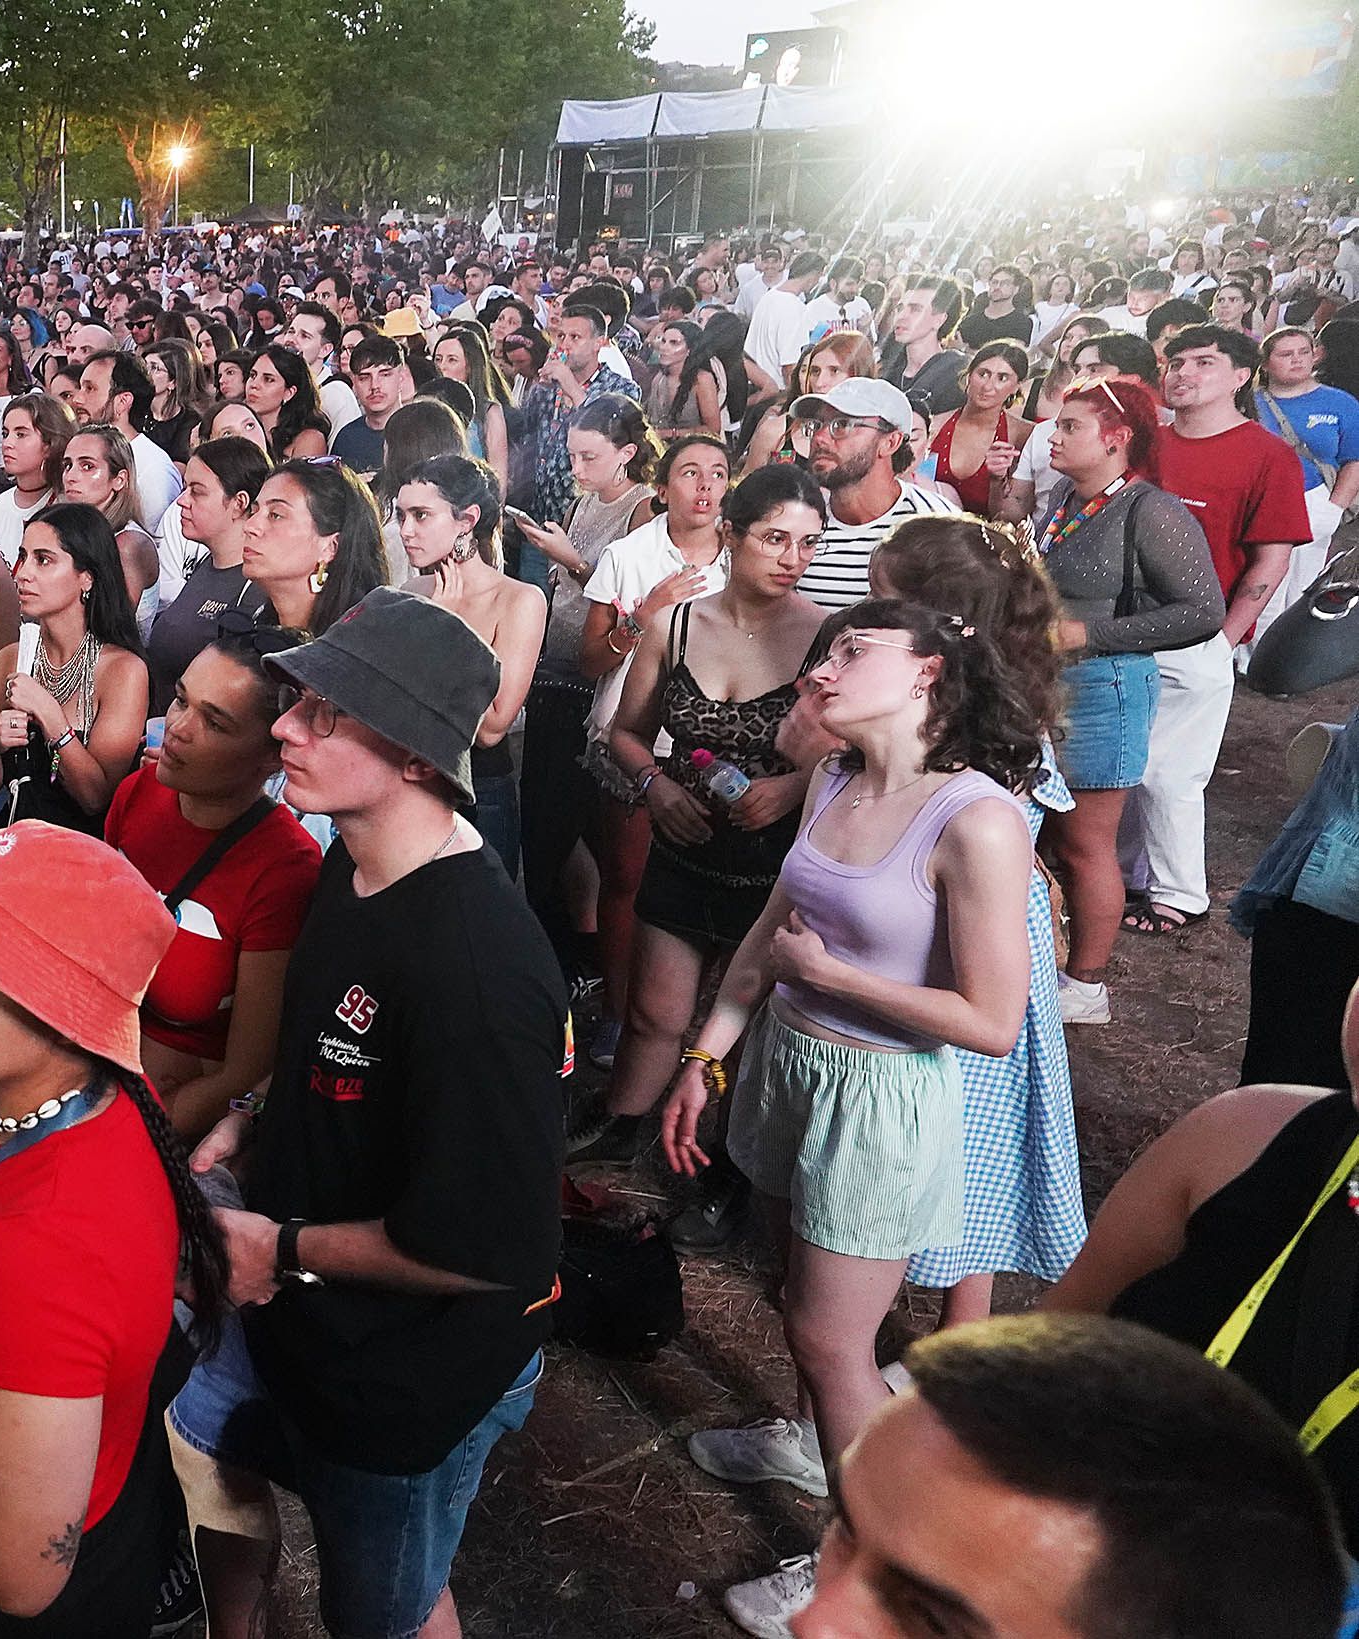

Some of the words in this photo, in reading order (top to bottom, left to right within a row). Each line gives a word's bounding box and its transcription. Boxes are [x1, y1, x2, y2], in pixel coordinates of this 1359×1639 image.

[335, 984, 380, 1034] 95
[317, 1031, 360, 1055] Lightning
[319, 1046, 371, 1067] McQueen
